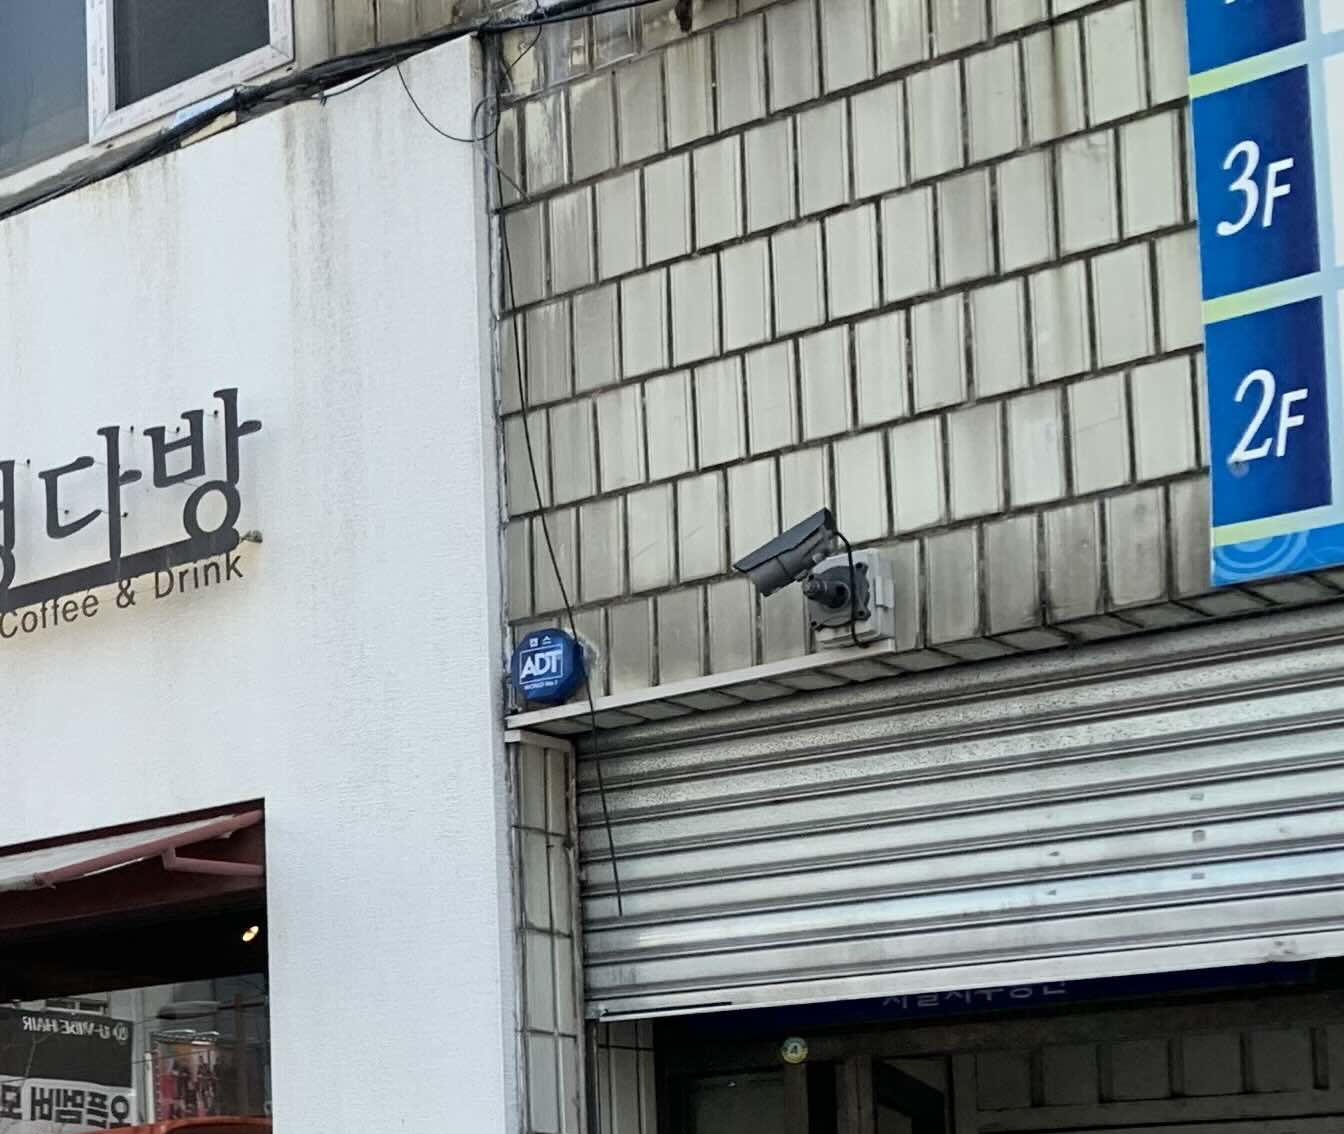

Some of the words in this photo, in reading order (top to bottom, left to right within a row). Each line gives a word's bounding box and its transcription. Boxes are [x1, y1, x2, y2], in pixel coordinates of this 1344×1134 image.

[1216, 139, 1295, 237] 3F
[1227, 368, 1309, 466] 2F
[115, 577, 137, 609] &
[153, 549, 245, 601] Drink
[519, 649, 563, 679] ADT
